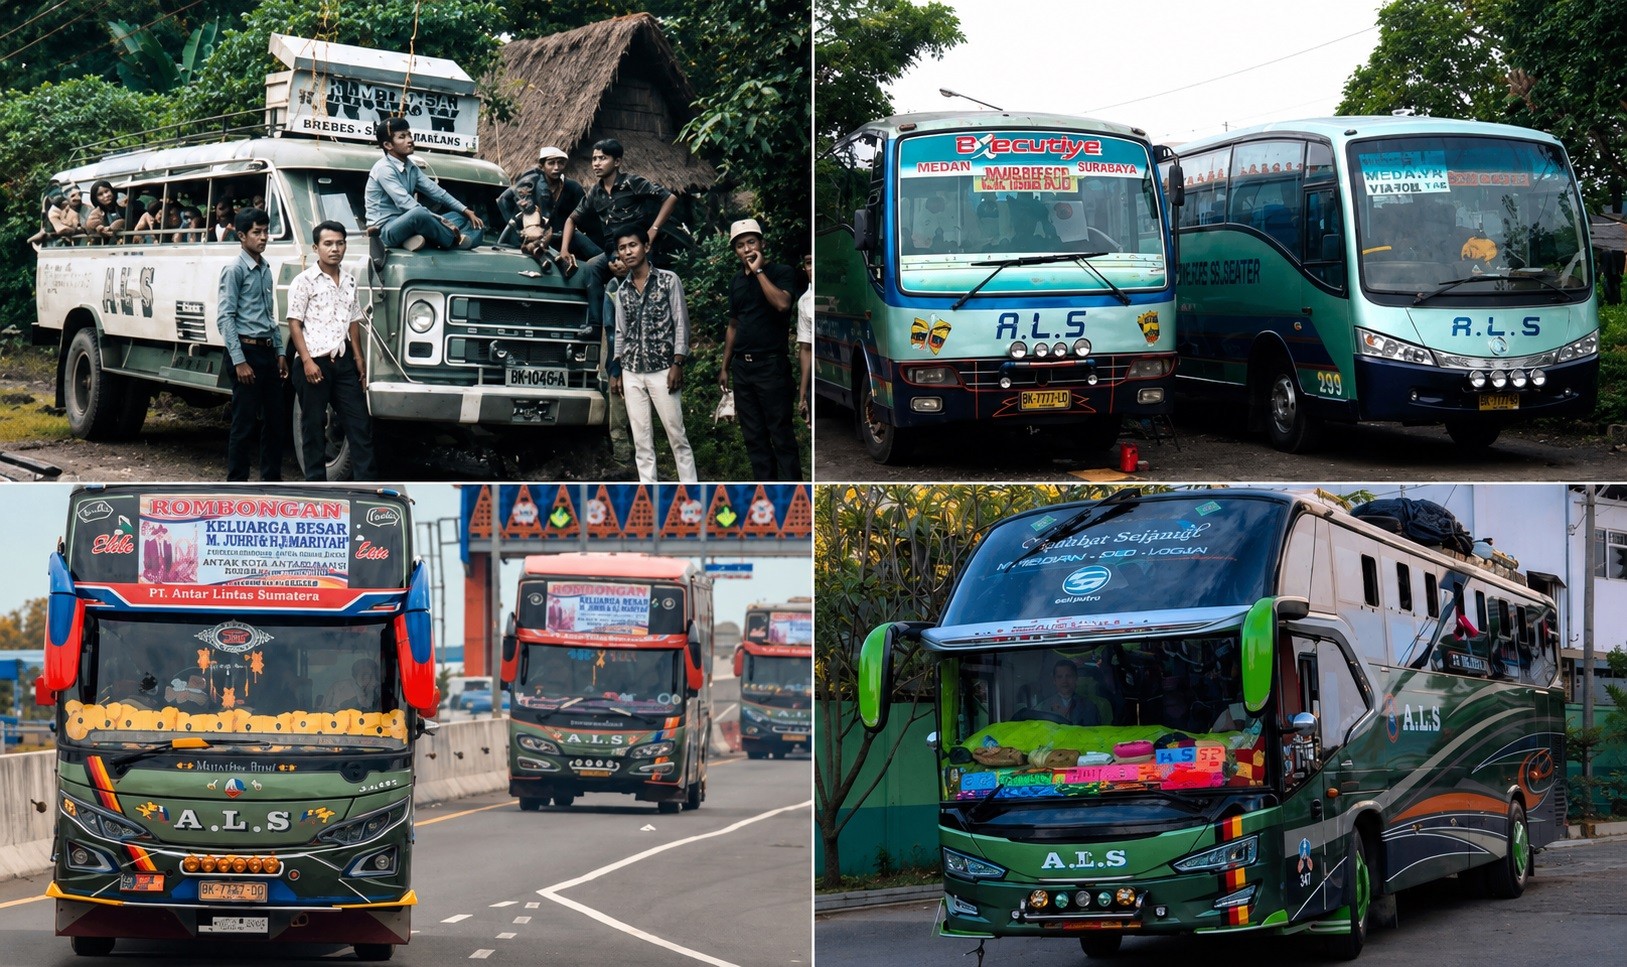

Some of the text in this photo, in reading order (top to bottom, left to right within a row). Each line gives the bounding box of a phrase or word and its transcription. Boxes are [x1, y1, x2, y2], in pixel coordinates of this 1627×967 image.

[303, 118, 355, 135] BREBES
[917, 161, 971, 173] MEDAN
[1078, 161, 1137, 175] SURABAYA
[511, 369, 566, 387] BK-1046-A
[1317, 371, 1342, 396] 299
[150, 498, 343, 520] ROMBONGAN
[205, 520, 348, 536] KELUARGA BESAR
[206, 533, 220, 547] M.
[223, 534, 258, 548] JUHRI
[149, 588, 320, 602] PT. Antar Lintas Sumatera
[567, 733, 623, 745] A.L.S
[173, 809, 292, 833] A.L.S
[1041, 850, 1128, 870] A.L.S
